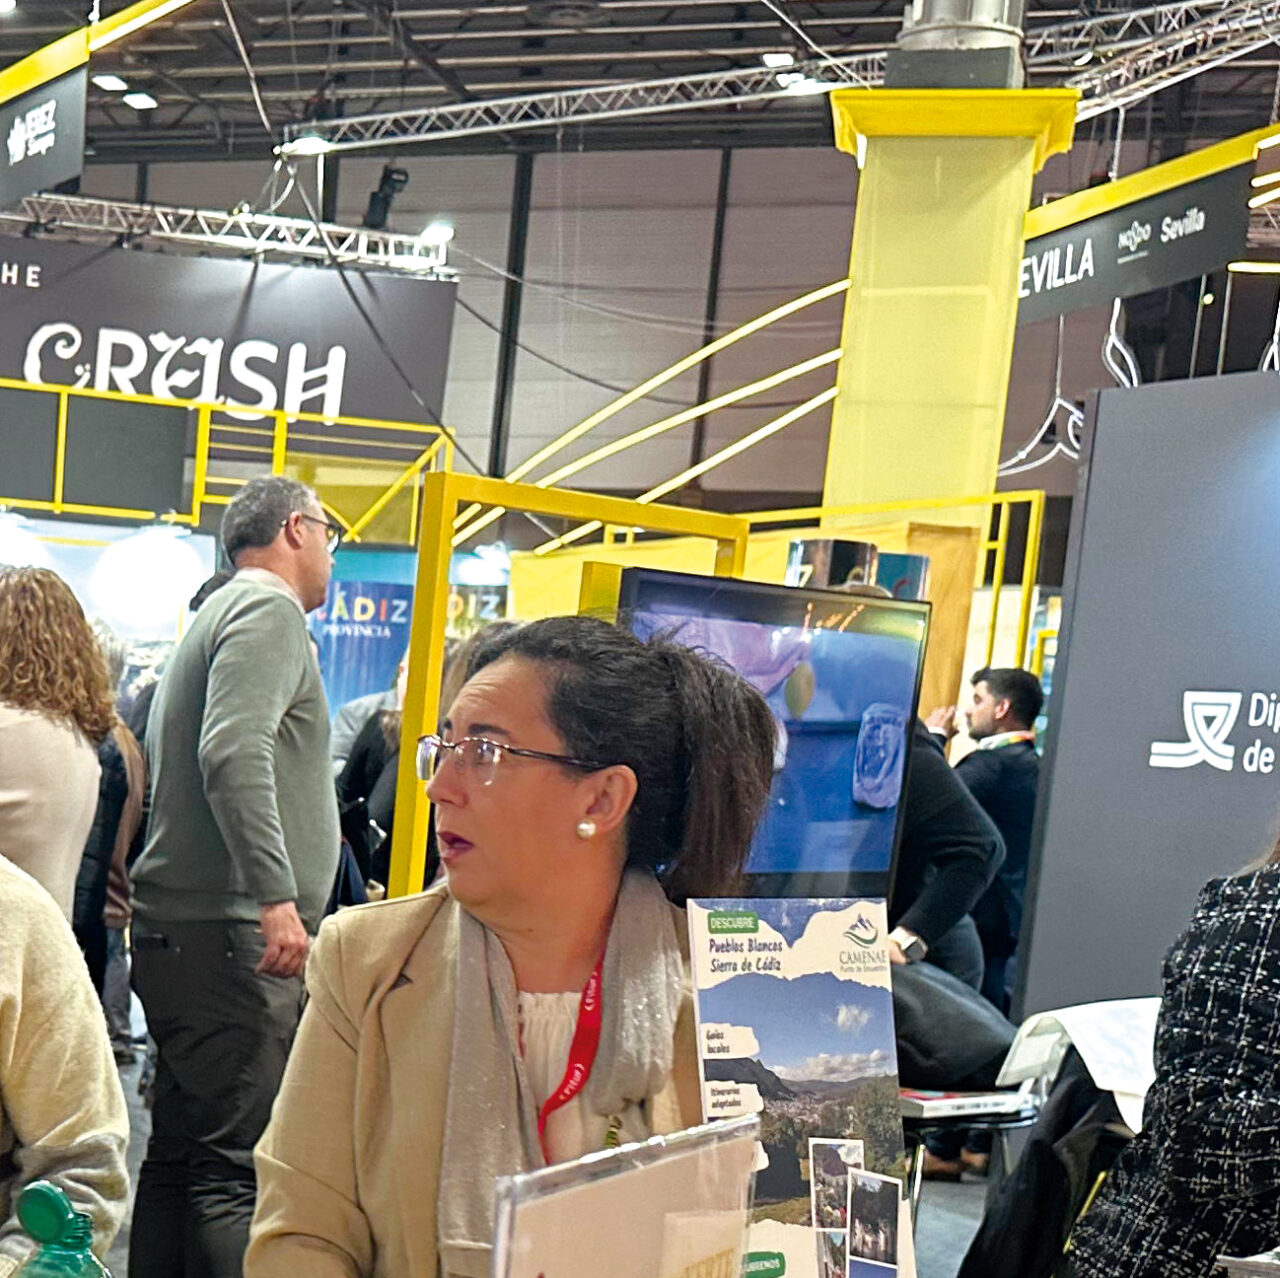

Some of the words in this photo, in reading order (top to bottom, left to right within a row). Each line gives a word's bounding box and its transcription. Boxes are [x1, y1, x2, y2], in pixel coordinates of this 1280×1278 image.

[1018, 237, 1095, 299] EVILLA
[1160, 206, 1206, 244] Sevilla
[23, 322, 347, 427] CRUSH
[447, 592, 501, 621] DIZ
[322, 623, 392, 640] PROVINCIA
[1242, 738, 1276, 774] de
[710, 916, 755, 929] DESCUBRE
[709, 937, 744, 953] Pueblos
[747, 937, 783, 952] Blancos
[710, 957, 737, 973] Sierra
[741, 958, 752, 971] de
[755, 955, 781, 971] Cádiz
